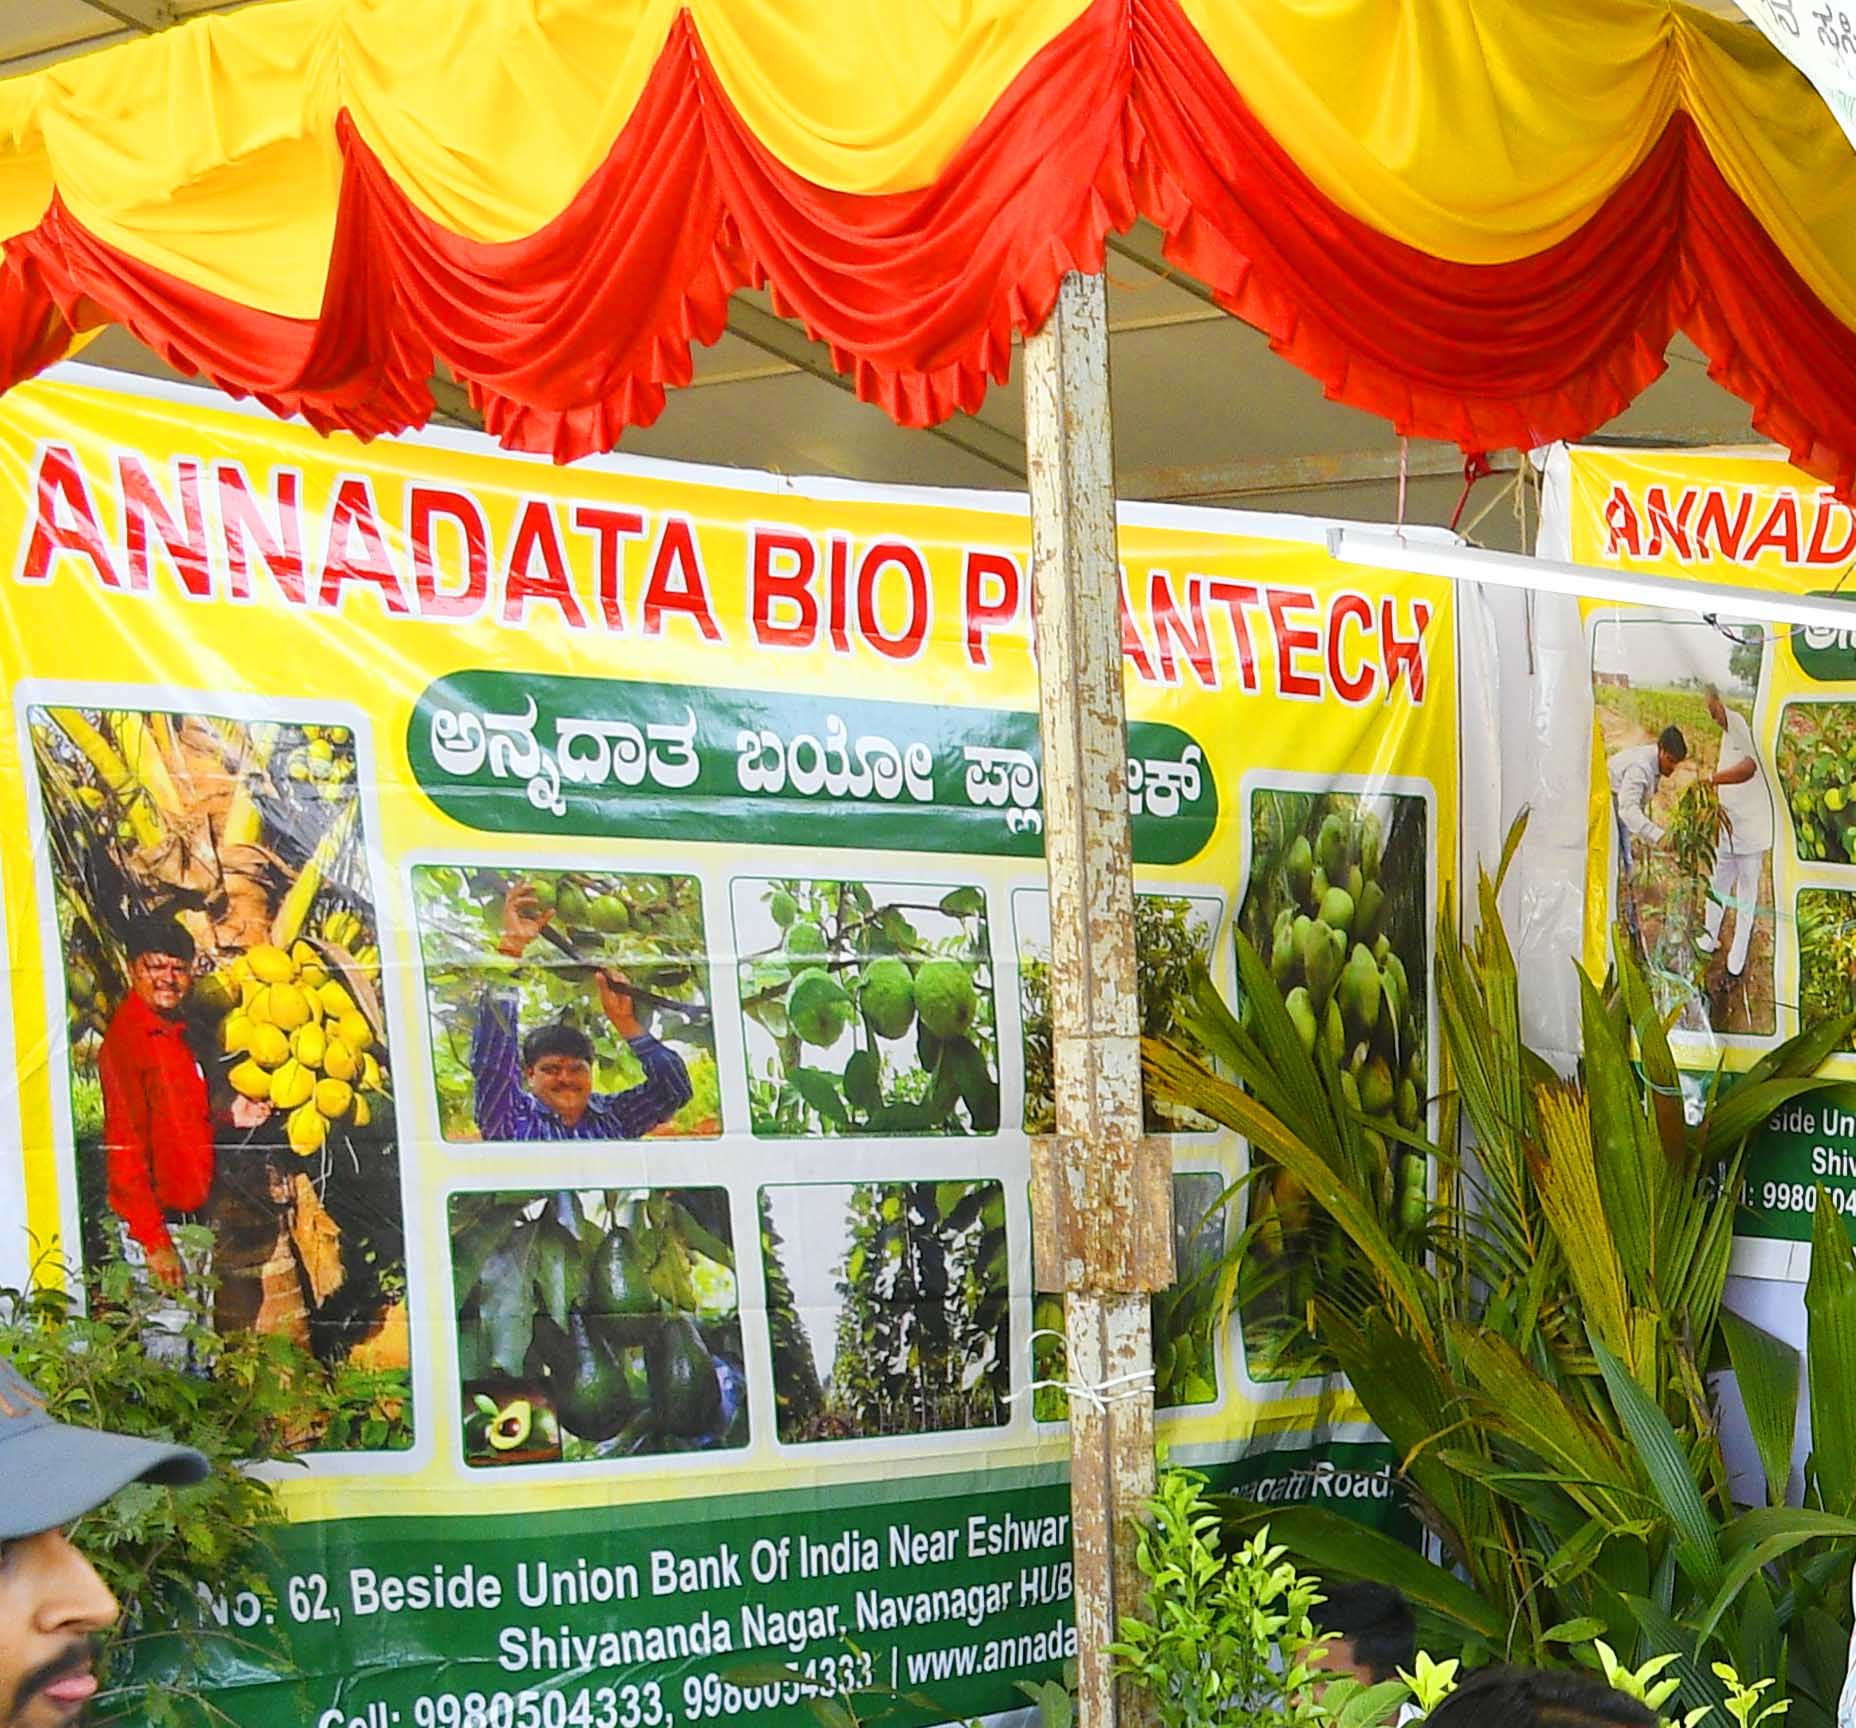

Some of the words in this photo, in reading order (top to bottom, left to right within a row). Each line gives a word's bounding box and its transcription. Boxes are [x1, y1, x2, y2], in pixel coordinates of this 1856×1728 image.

[22, 446, 723, 641] ANNADATA
[751, 530, 928, 661] BIO
[964, 551, 1432, 704] PANTECH
[430, 694, 698, 817] ಅನ್ನದಾತ
[736, 714, 934, 801] ಬಯೋ
[1769, 1106, 1815, 1135] side
[288, 1573, 341, 1626] 62,
[349, 1564, 503, 1616] Beside
[517, 1556, 639, 1608] Union
[650, 1544, 743, 1596] Bank
[750, 1537, 791, 1583] Of
[799, 1528, 880, 1579] India
[888, 1522, 960, 1568] Near
[967, 1512, 1070, 1558] Eshwar
[498, 1608, 732, 1672] Shivananda
[740, 1603, 848, 1653] Nagar,
[855, 1581, 1013, 1628] Navanagar
[1018, 1562, 1074, 1608] HUB
[906, 1618, 1080, 1686] www.annada
